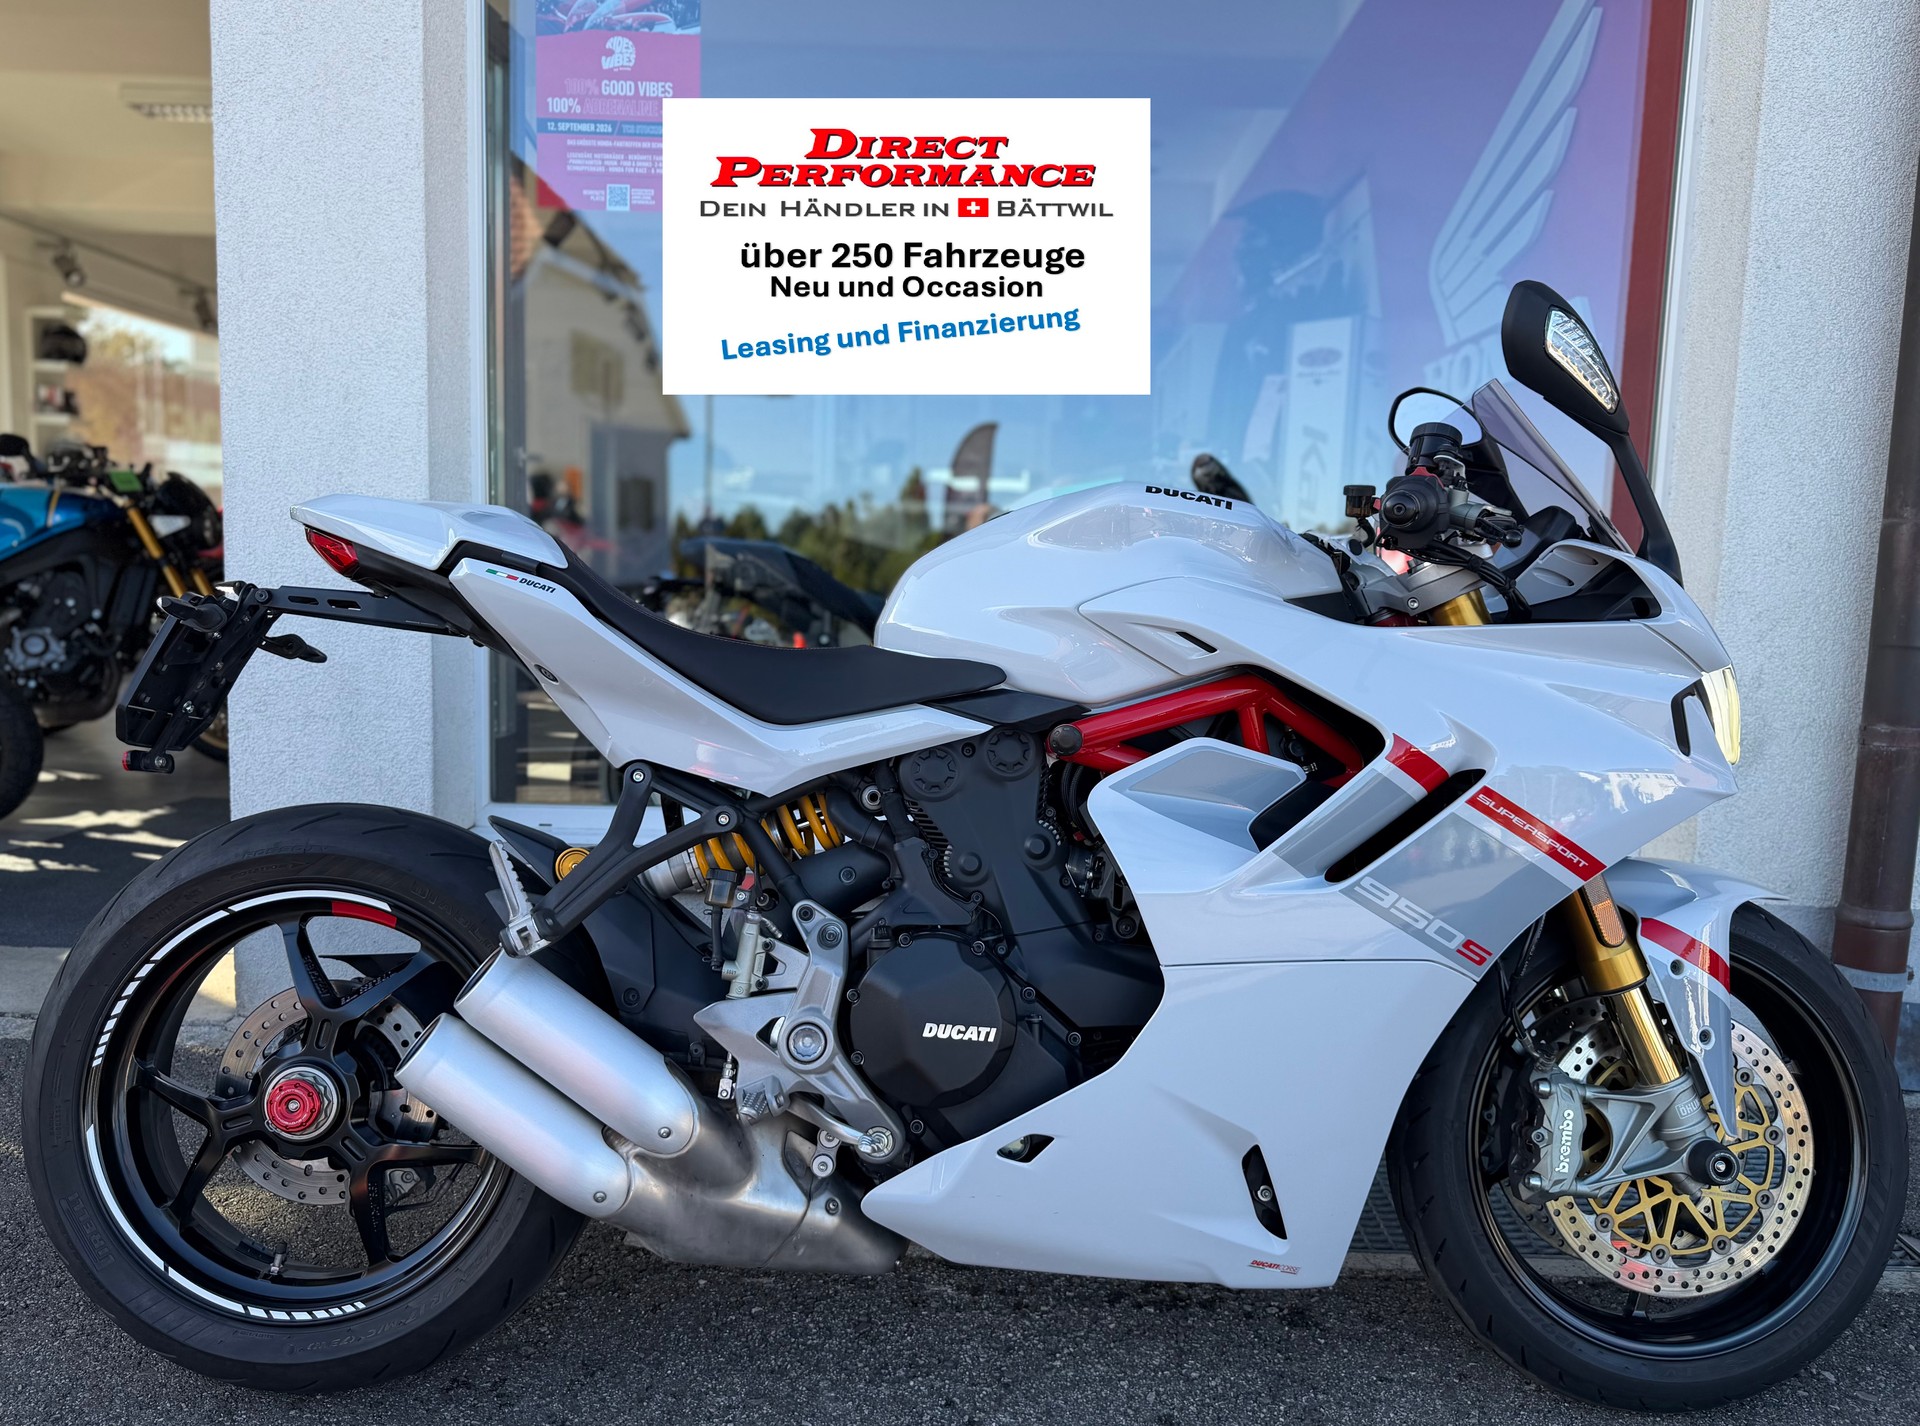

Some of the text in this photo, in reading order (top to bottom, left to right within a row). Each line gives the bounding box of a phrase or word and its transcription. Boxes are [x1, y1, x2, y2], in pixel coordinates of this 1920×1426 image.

[601, 80, 635, 96] GOOD
[637, 81, 673, 98] VIBES
[547, 97, 581, 114] 100%
[557, 121, 595, 133] SEPTEMBER
[1145, 485, 1232, 510] DUCATI
[519, 577, 556, 594] DUCATI
[1476, 793, 1589, 868] SUPERSPORT
[922, 1022, 997, 1043] DUCATI
[1555, 1109, 1575, 1173] brembo
